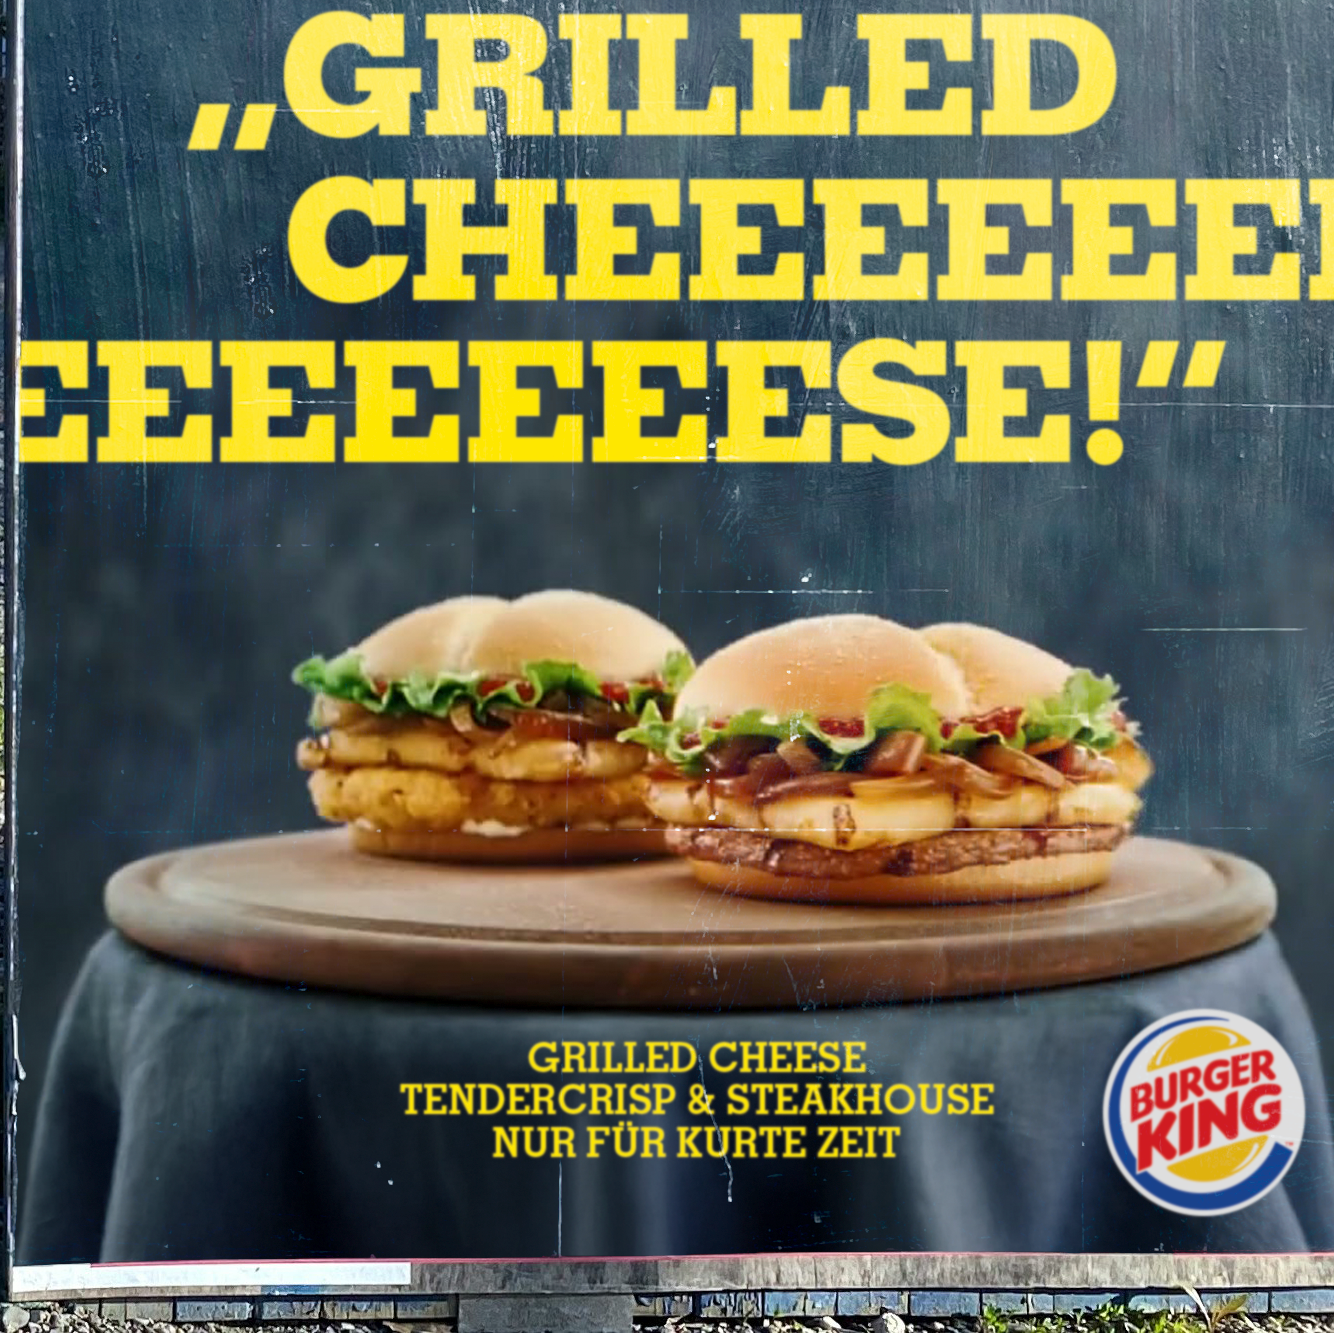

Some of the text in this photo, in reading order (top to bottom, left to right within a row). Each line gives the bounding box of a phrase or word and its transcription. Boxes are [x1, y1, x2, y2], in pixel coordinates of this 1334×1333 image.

[288, 176, 1334, 303] CHEEEEEE
[528, 1040, 867, 1074] GRILLED CHEESE
[400, 1082, 995, 1116] TENDERCRISP & STEAKHOUSE
[1130, 1049, 1276, 1123] BURGER
[492, 1120, 901, 1159] NUR FÜR KURTE ZEIT
[1137, 1083, 1282, 1172] KING
